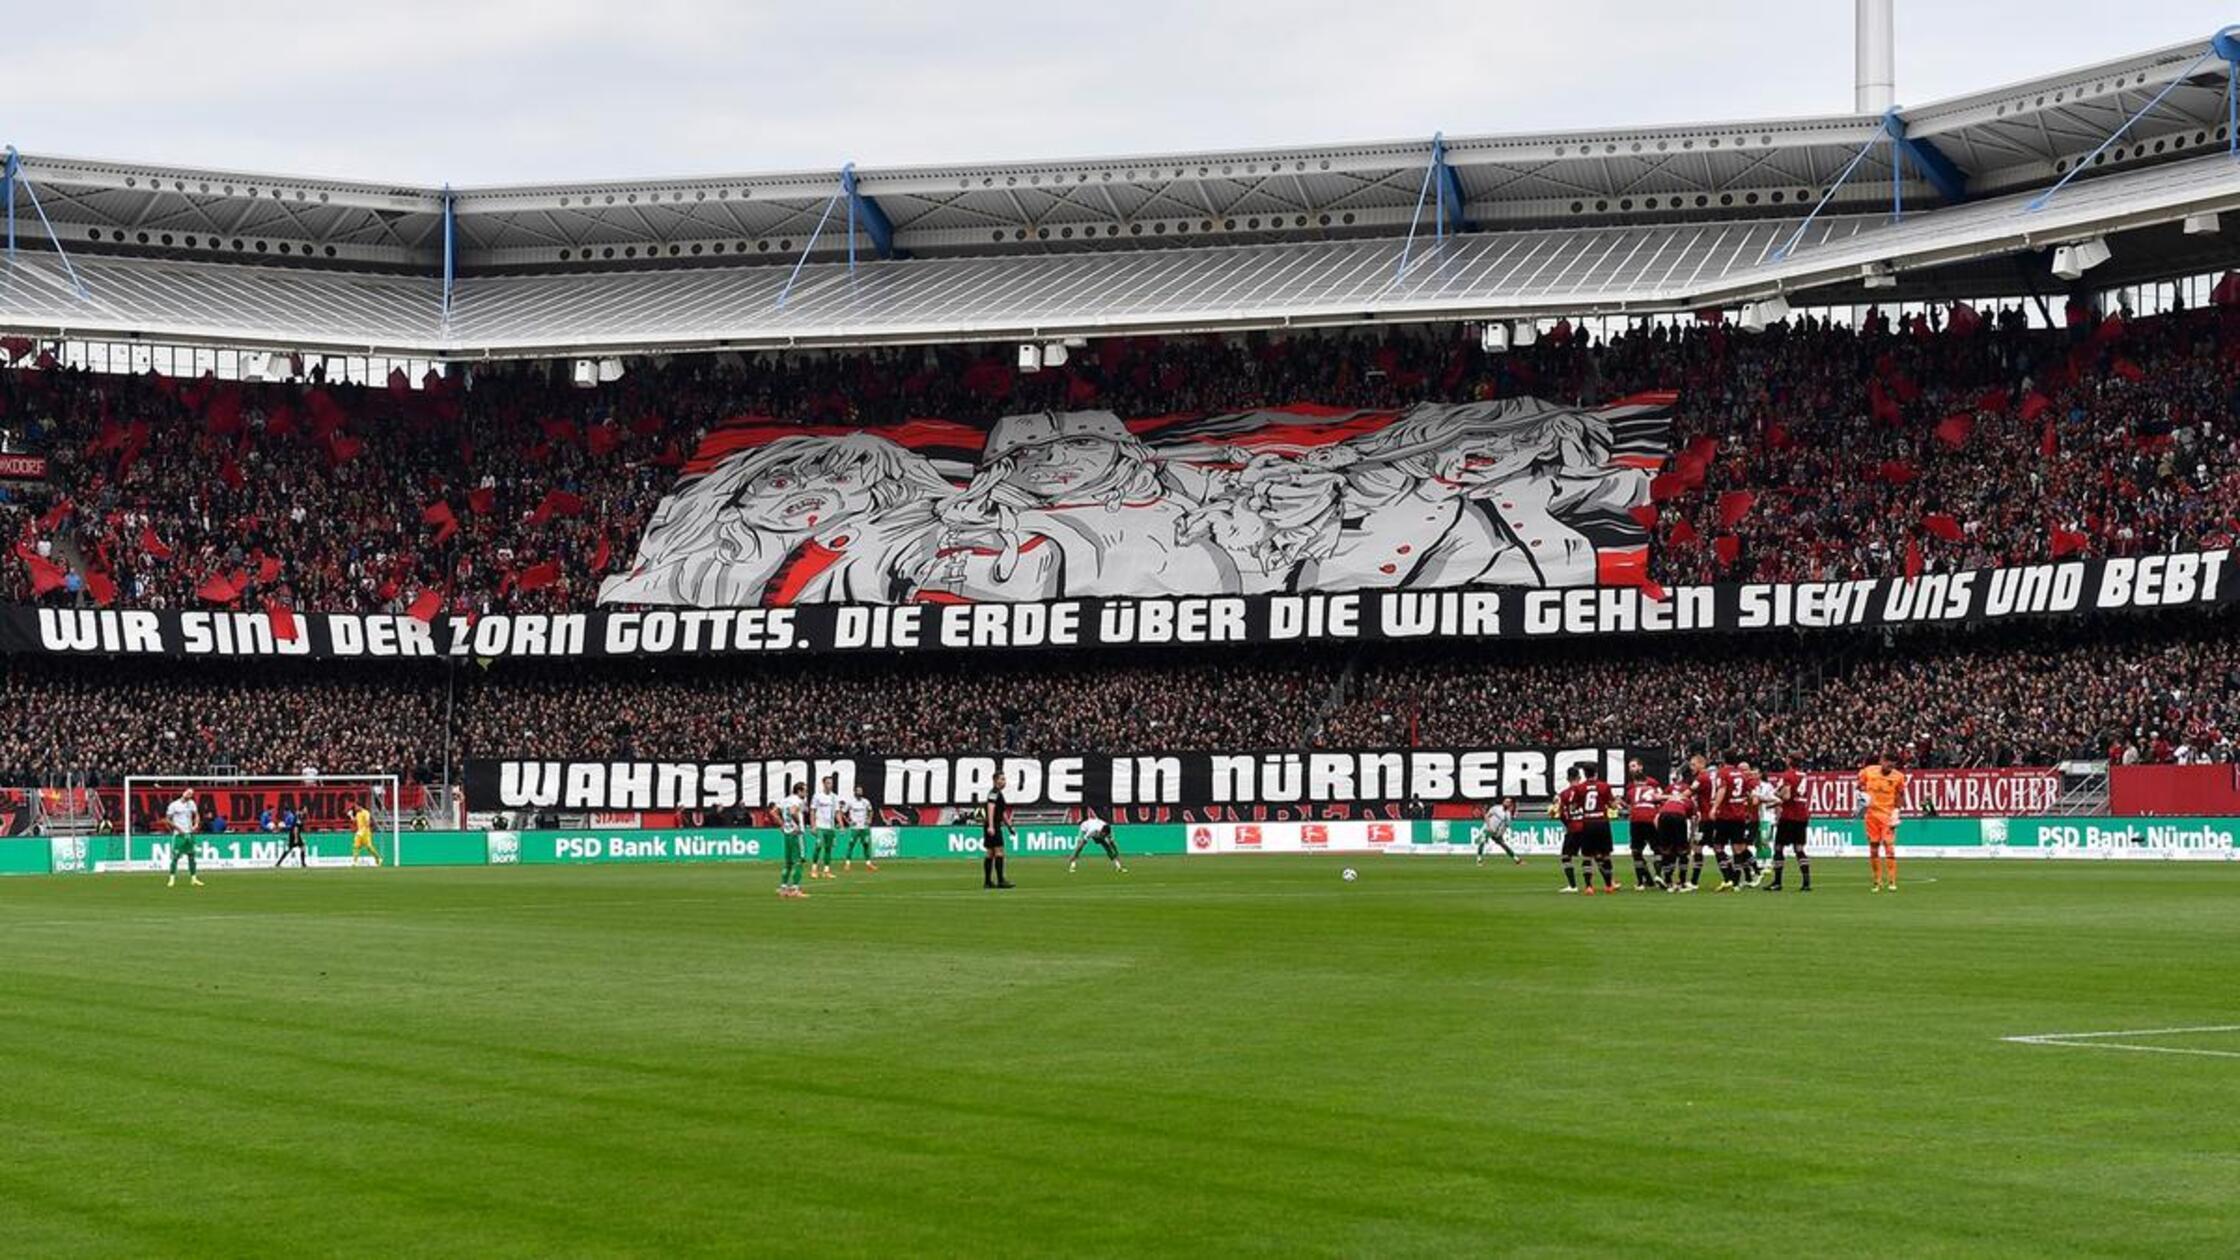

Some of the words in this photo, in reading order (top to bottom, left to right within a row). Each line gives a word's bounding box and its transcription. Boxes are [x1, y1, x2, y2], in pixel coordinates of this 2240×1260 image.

[38, 609, 164, 652] WIR
[328, 614, 436, 656] DER
[449, 613, 586, 656] ZORN
[605, 608, 810, 654] GOTTES.
[834, 605, 922, 648] DIE
[940, 602, 1080, 647] ERDE
[1100, 599, 1247, 643] ÜBER
[1269, 595, 1359, 639] DIE
[1380, 591, 1500, 637] WIR
[1524, 585, 1715, 635] GEHEN
[1738, 579, 1876, 628] SIEHT
[1883, 571, 1977, 621] UNS
[1986, 561, 2086, 616] UND
[2097, 550, 2229, 608] BEBT
[500, 758, 857, 809] WAHNSINN
[884, 755, 1085, 804] MADE
[1111, 756, 1181, 804] IN
[1732, 777, 1744, 797] 3
[1585, 791, 1599, 811] 6
[554, 837, 601, 858] PSD
[609, 836, 662, 856] Bank
[674, 834, 760, 856] Nürnbe
[948, 832, 988, 852] Noc
[1027, 830, 1079, 851] Minu
[2038, 825, 2080, 848] PSD
[2085, 824, 2140, 848] Bank
[2147, 824, 2233, 848] Nürnbe
